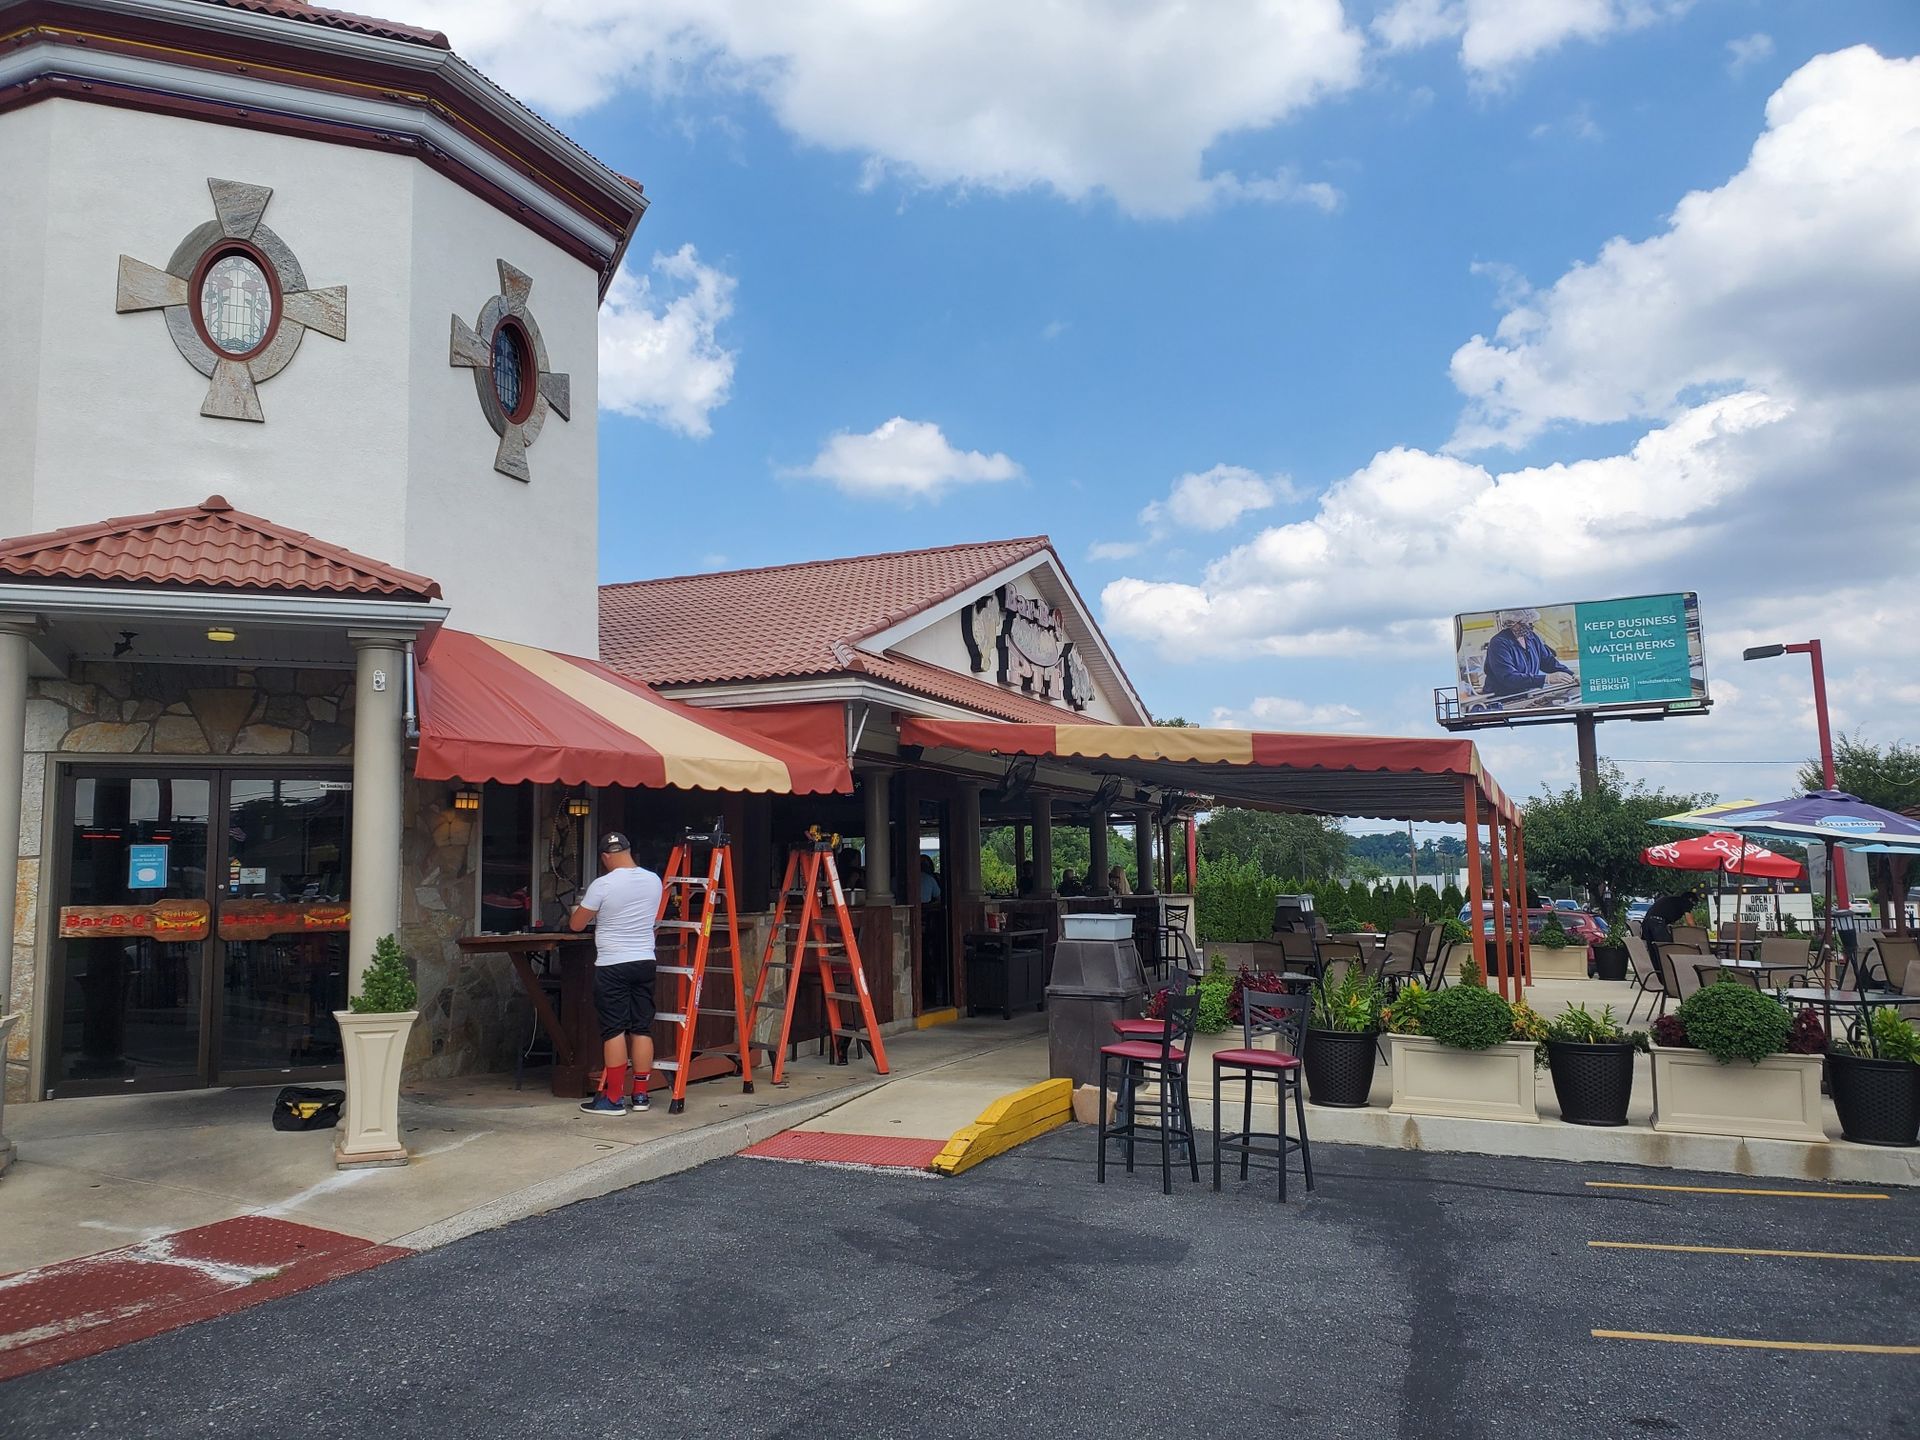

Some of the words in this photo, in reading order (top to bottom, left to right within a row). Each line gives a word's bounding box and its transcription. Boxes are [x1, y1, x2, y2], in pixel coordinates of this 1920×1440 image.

[1584, 621, 1615, 631] KEEP
[1618, 615, 1677, 628] BUSINESS
[1610, 628, 1652, 639] LOCAL.
[1589, 642, 1633, 654] WATCH
[1636, 639, 1676, 650] BERKS
[1609, 651, 1656, 663] THRIVE.
[1589, 676, 1628, 685] REBUILD
[1745, 904, 1769, 912] INDOOR
[65, 914, 145, 928] Bar-B-Q
[1733, 913, 1761, 922] OTDOOR
